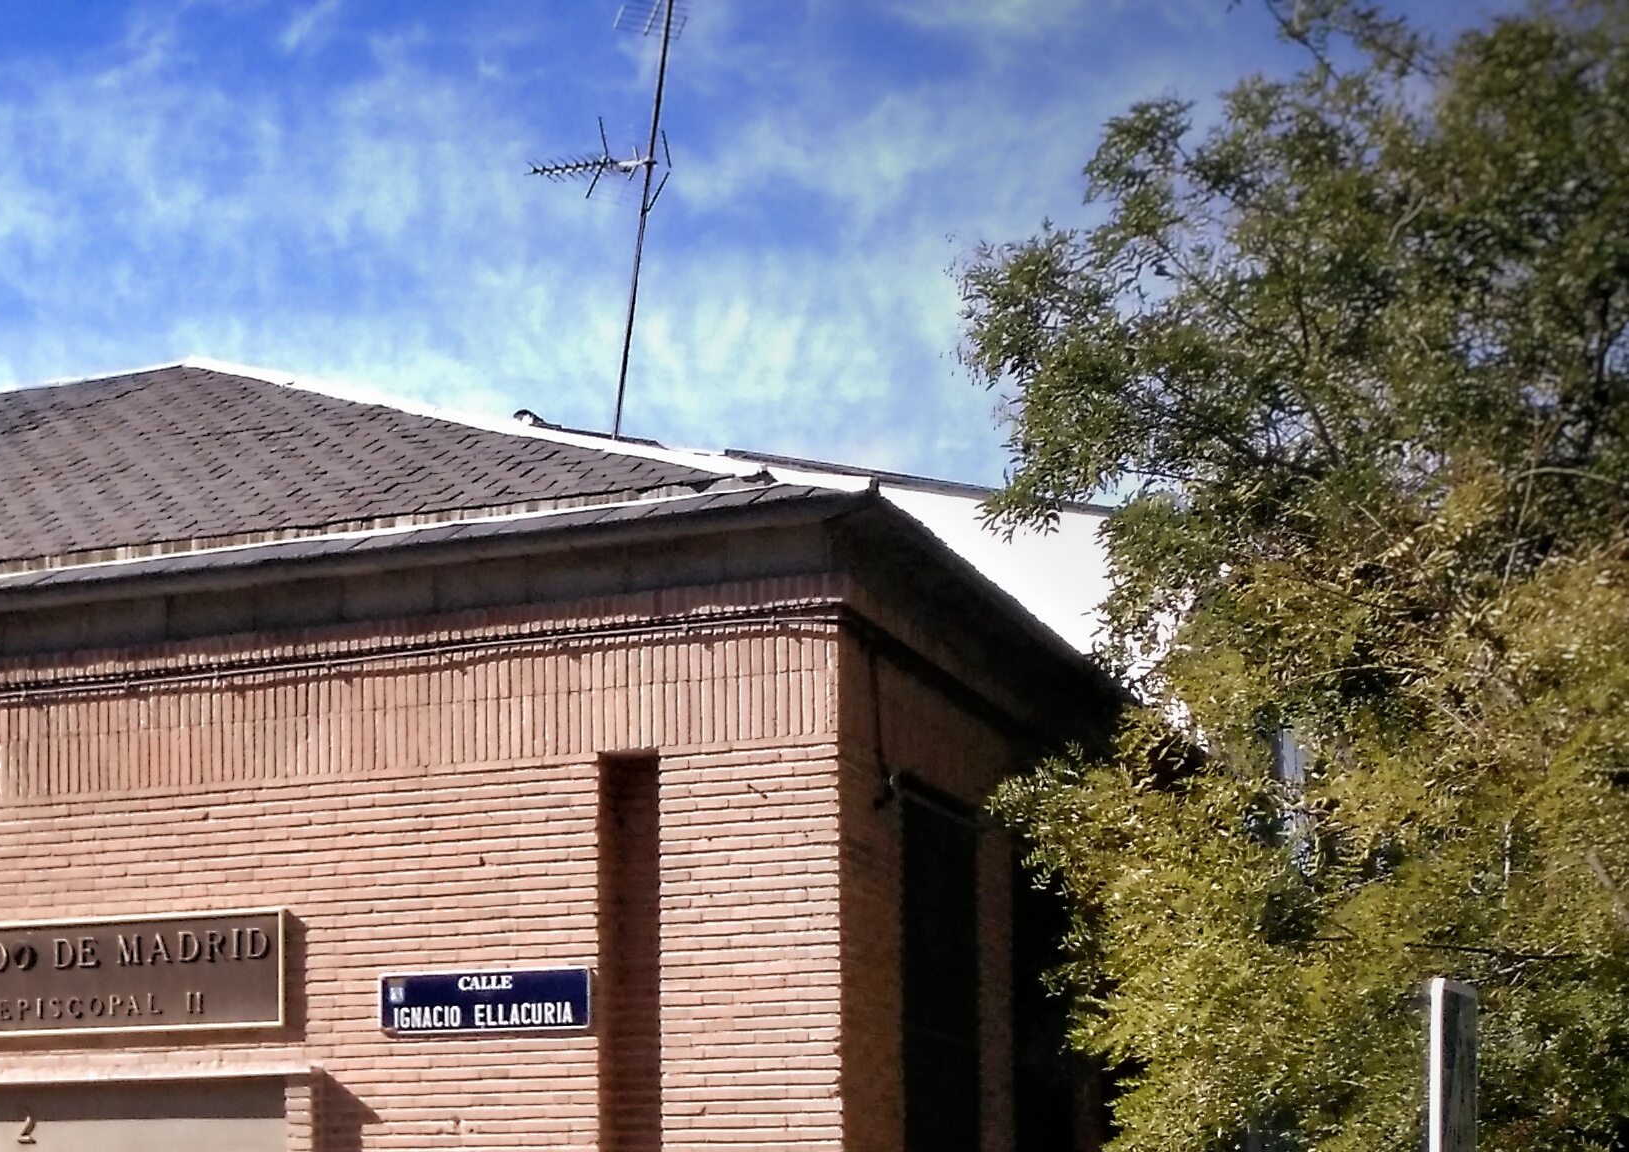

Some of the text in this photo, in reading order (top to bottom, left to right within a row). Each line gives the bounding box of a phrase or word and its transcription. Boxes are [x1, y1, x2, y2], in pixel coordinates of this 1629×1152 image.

[54, 937, 101, 969] DE
[117, 927, 270, 966] MADRID
[458, 974, 513, 991] CALLE
[0, 992, 163, 1022] EPISCOPAL
[186, 991, 204, 1014] II
[393, 1001, 574, 1029] IGNACIO ELLACURIA
[17, 1109, 37, 1145] 2
